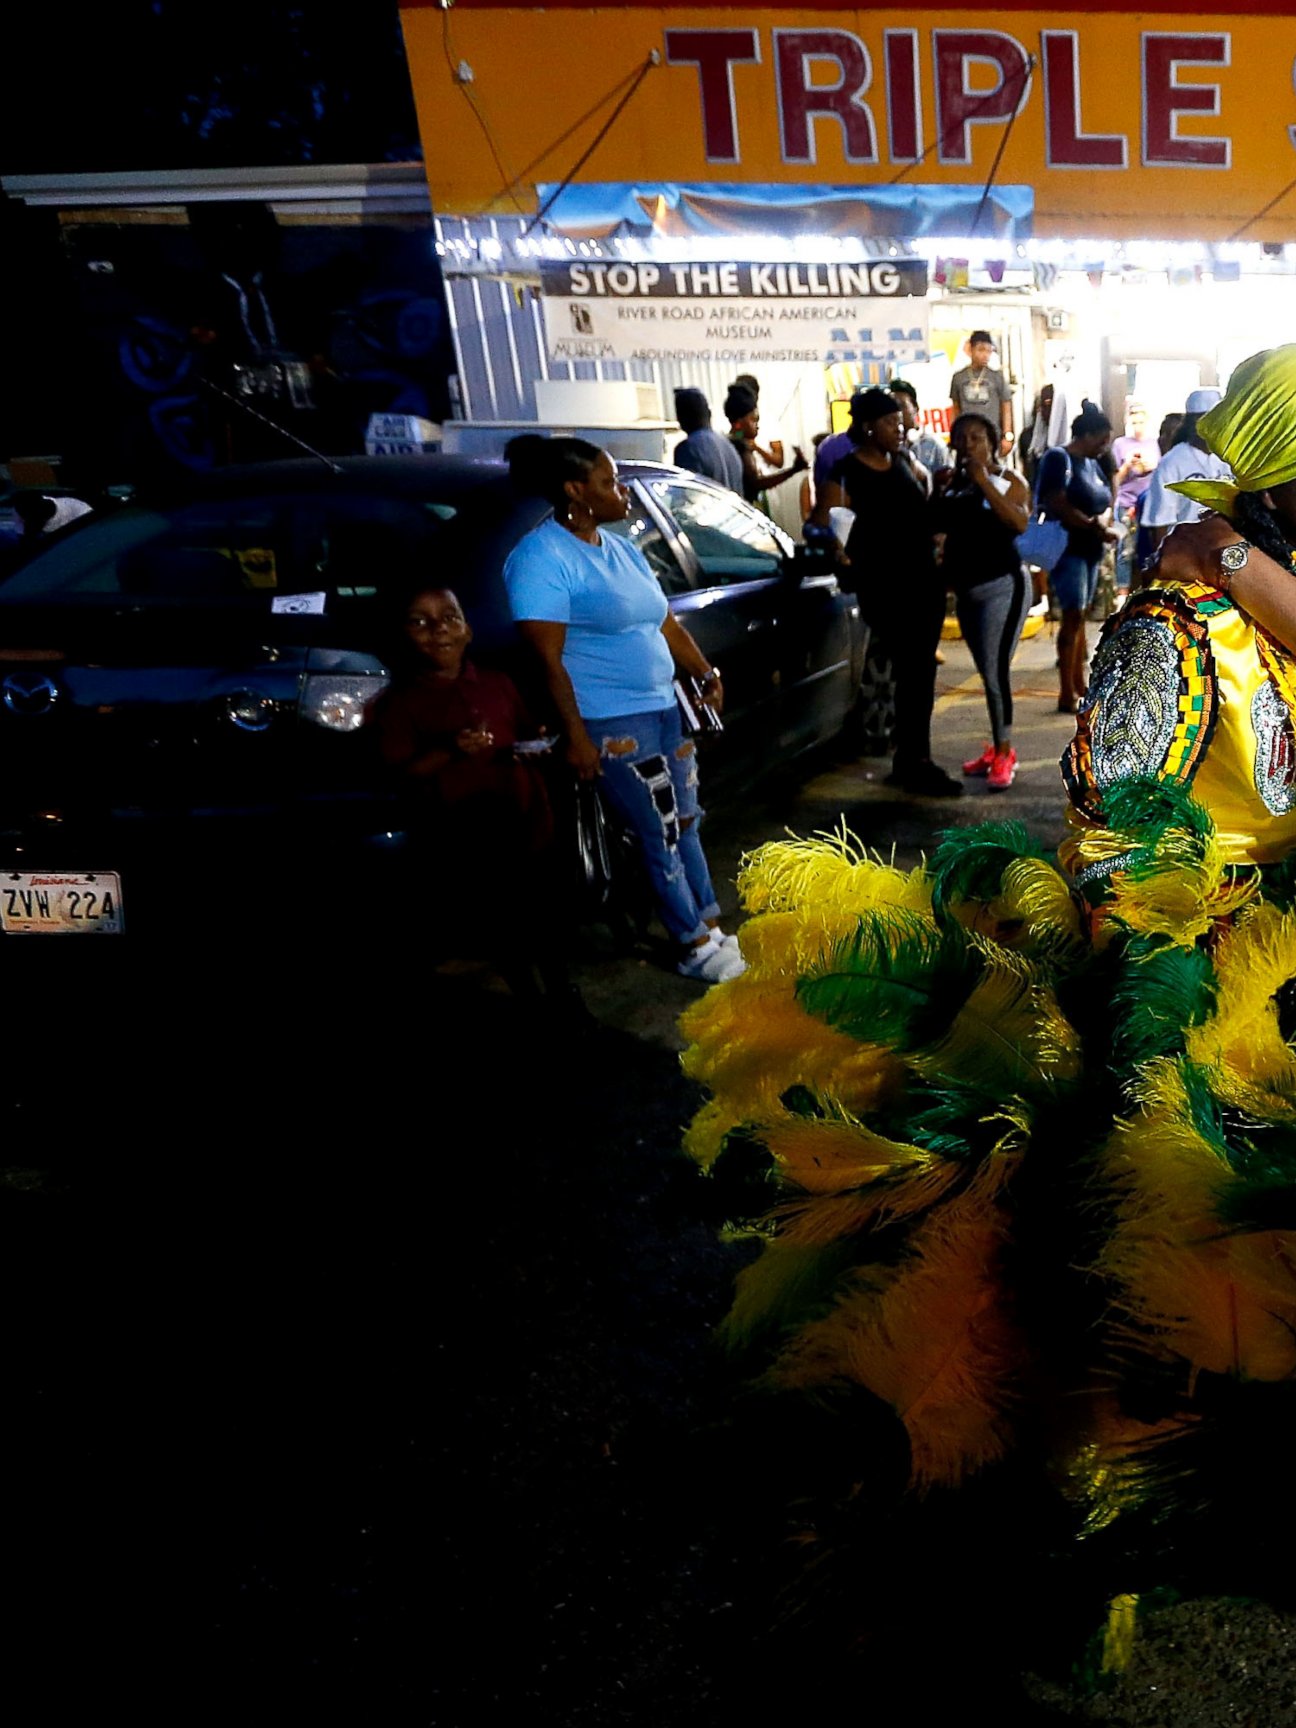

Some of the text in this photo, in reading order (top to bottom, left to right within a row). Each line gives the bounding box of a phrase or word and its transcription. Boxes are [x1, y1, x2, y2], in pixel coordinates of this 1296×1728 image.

[664, 28, 1231, 169] TRIPLE
[569, 262, 900, 295] STOP THE KILLING
[617, 306, 857, 320] RIVER ROAD AFRICAN AMERICAN
[705, 325, 772, 338] MUSEUM
[631, 349, 818, 360] ABOUNDING LOVE MINISTRIES
[3, 888, 115, 919] ZVW 224
